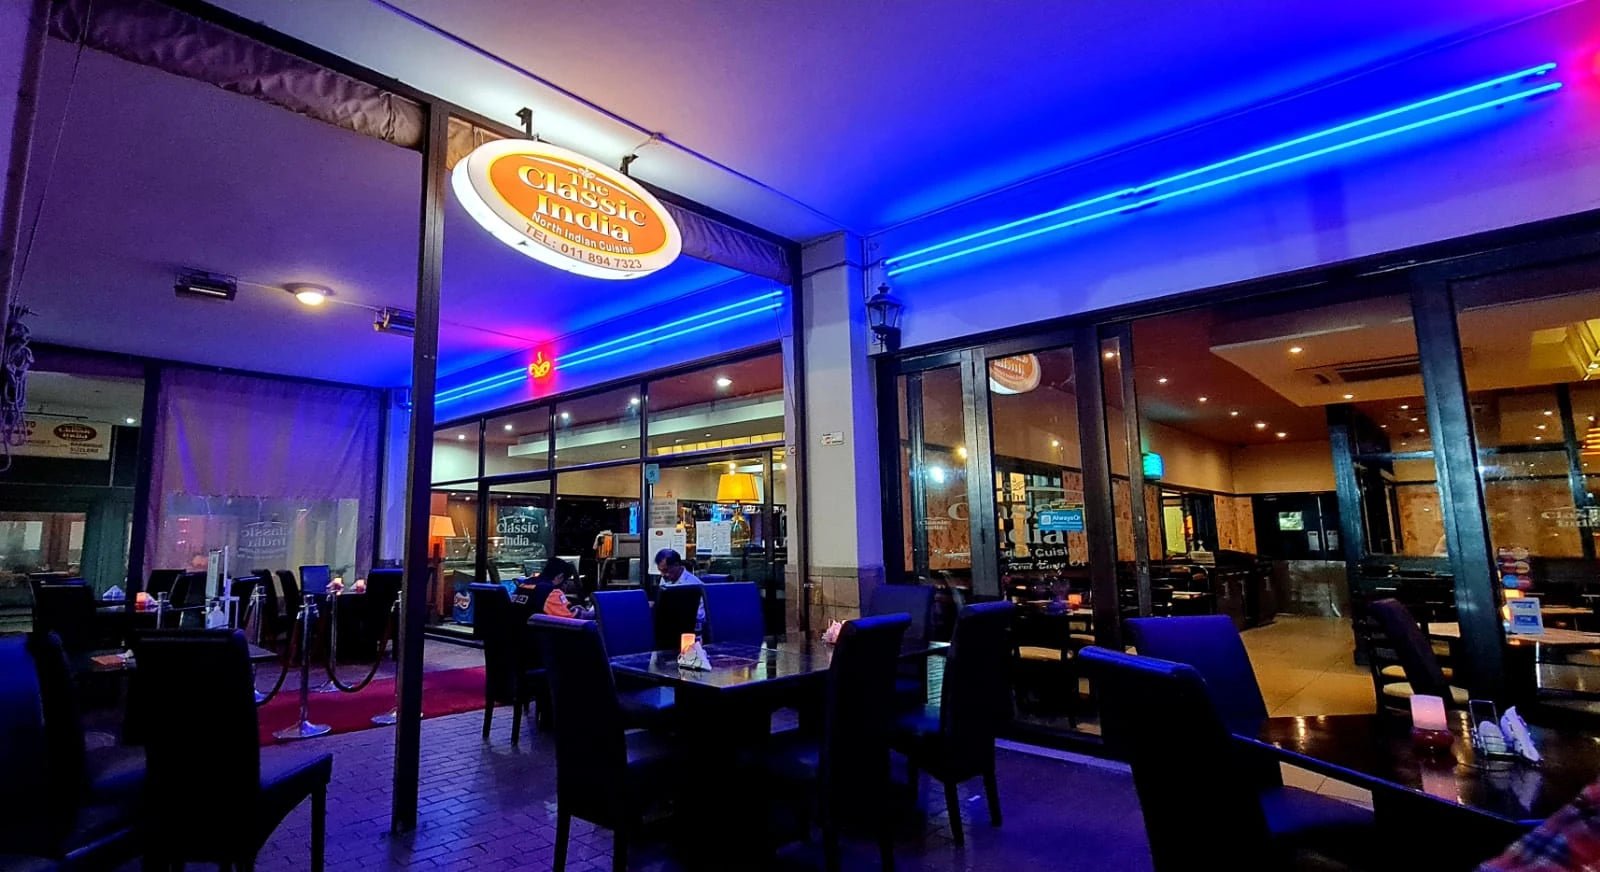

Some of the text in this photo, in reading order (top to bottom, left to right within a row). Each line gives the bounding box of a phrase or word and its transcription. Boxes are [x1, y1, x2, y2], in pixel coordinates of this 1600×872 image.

[518, 165, 646, 227] Classic
[568, 171, 609, 196] The
[532, 211, 634, 254] North Indian Cuisine
[536, 195, 630, 243] India
[526, 221, 642, 269] TEL: 011 894 7323
[496, 517, 539, 534] Classic
[503, 534, 529, 546] India
[1035, 547, 1069, 557] Cuisi
